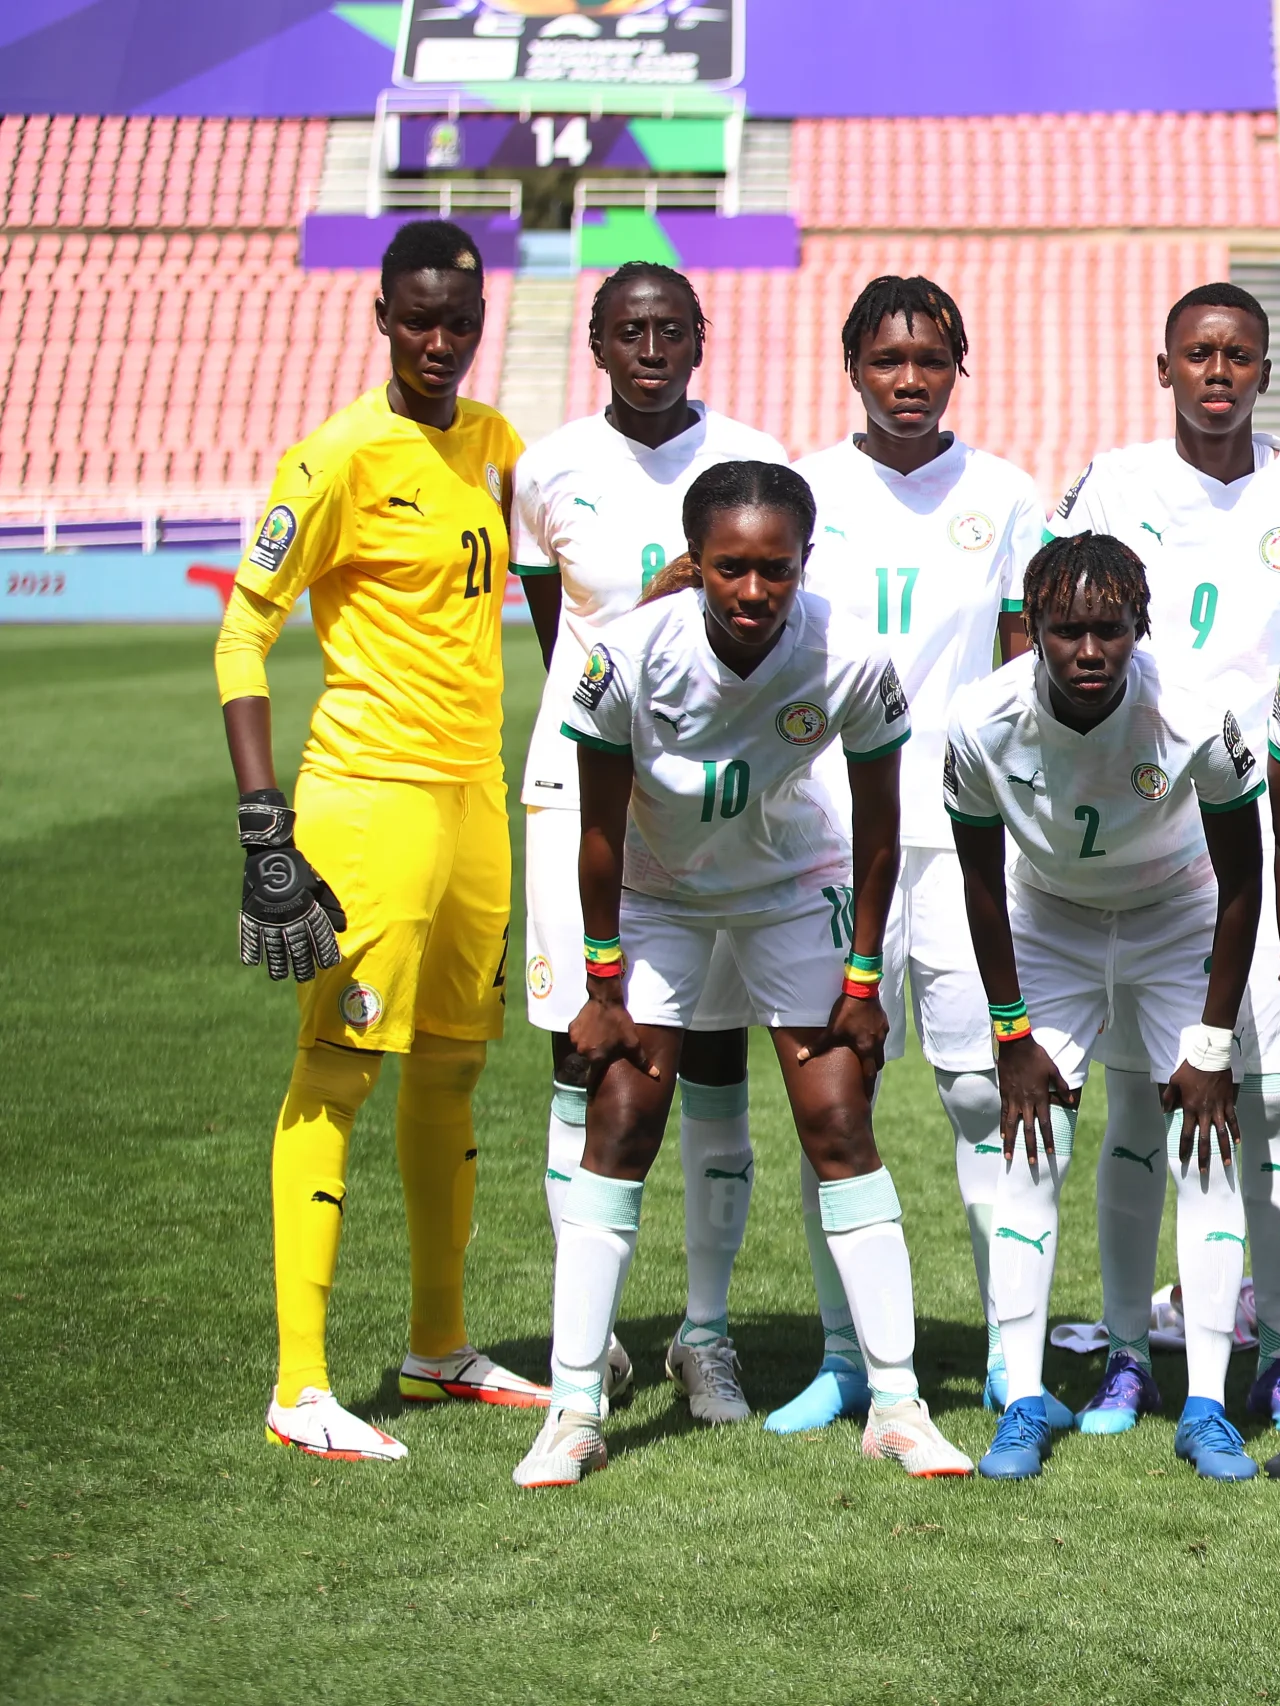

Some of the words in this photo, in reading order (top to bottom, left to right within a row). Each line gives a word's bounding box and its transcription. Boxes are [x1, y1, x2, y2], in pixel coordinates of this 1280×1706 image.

[531, 116, 593, 167] 14
[5, 570, 67, 597] 2022
[461, 527, 492, 600] 21
[875, 567, 920, 635] 17
[1189, 582, 1219, 650] 9
[700, 759, 750, 823] 10
[1074, 804, 1107, 859] 2
